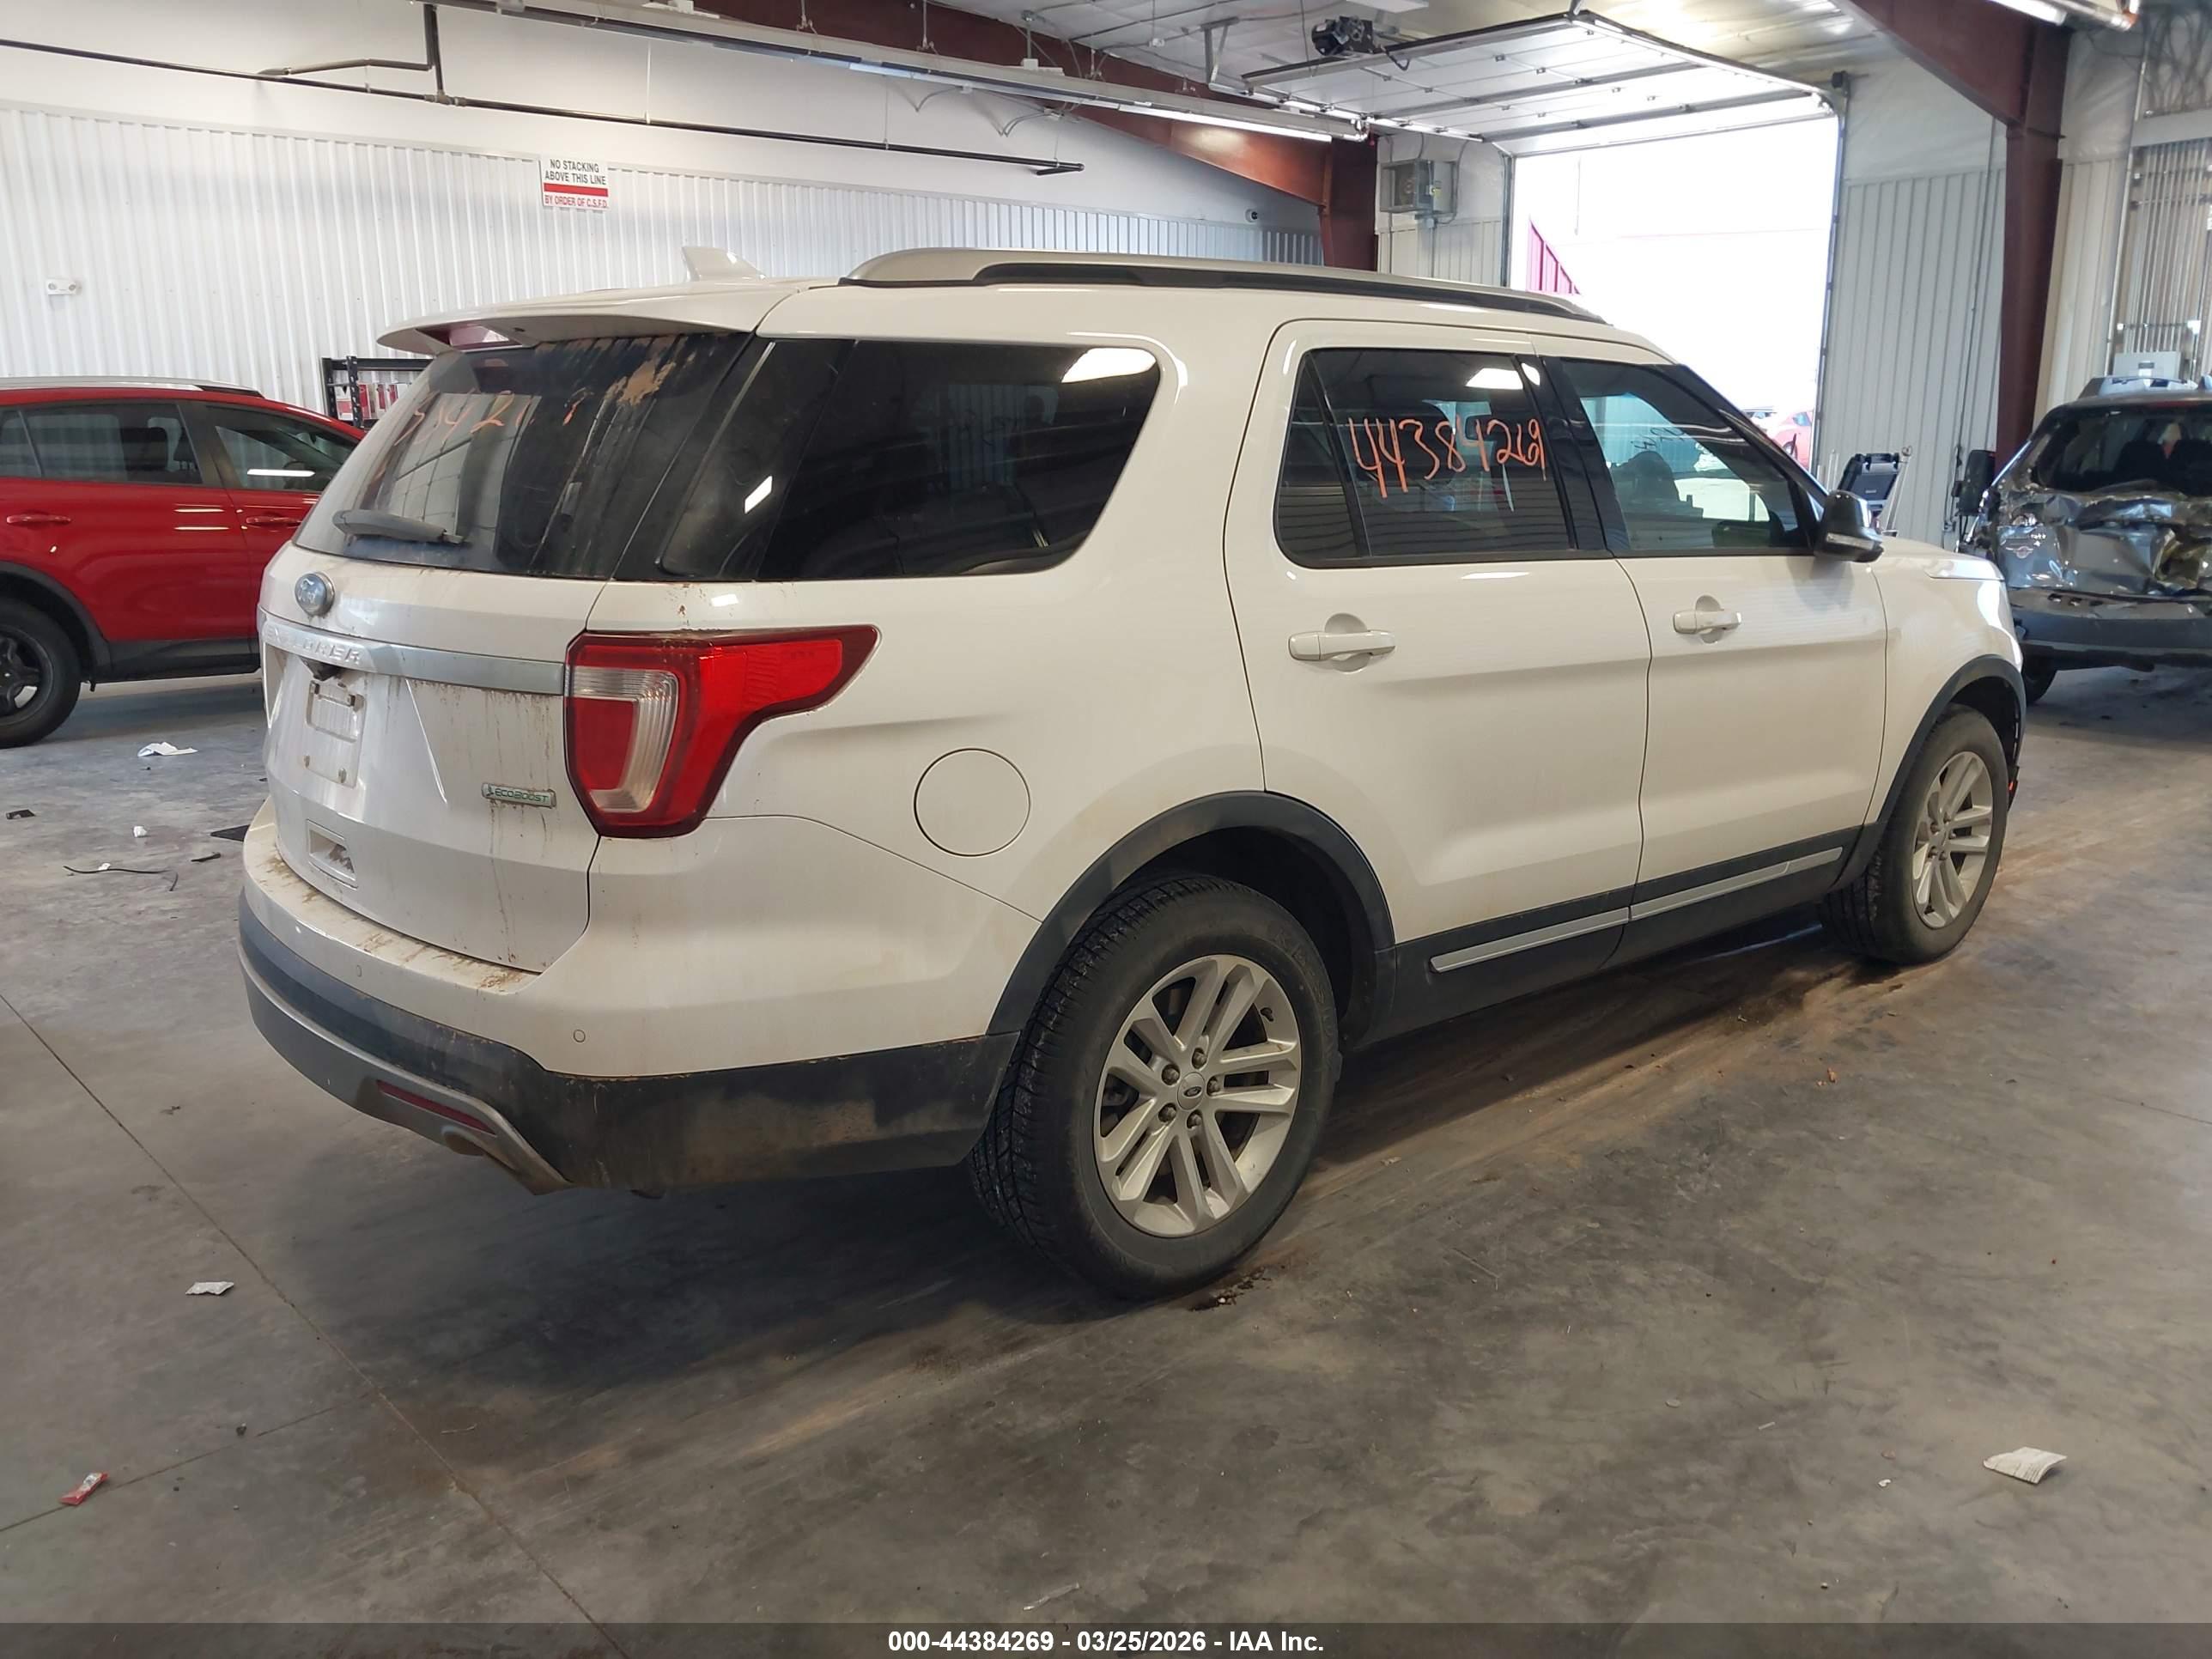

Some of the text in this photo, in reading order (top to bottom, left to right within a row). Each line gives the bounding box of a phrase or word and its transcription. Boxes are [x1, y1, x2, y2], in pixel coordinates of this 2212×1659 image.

[550, 159, 599, 173] NO STACKING
[545, 170, 606, 185] ABOVE THIS LINE
[544, 195, 554, 204] BY
[555, 196, 575, 206] ORDER
[577, 198, 585, 207] OF
[1348, 416, 1547, 498] 44384269
